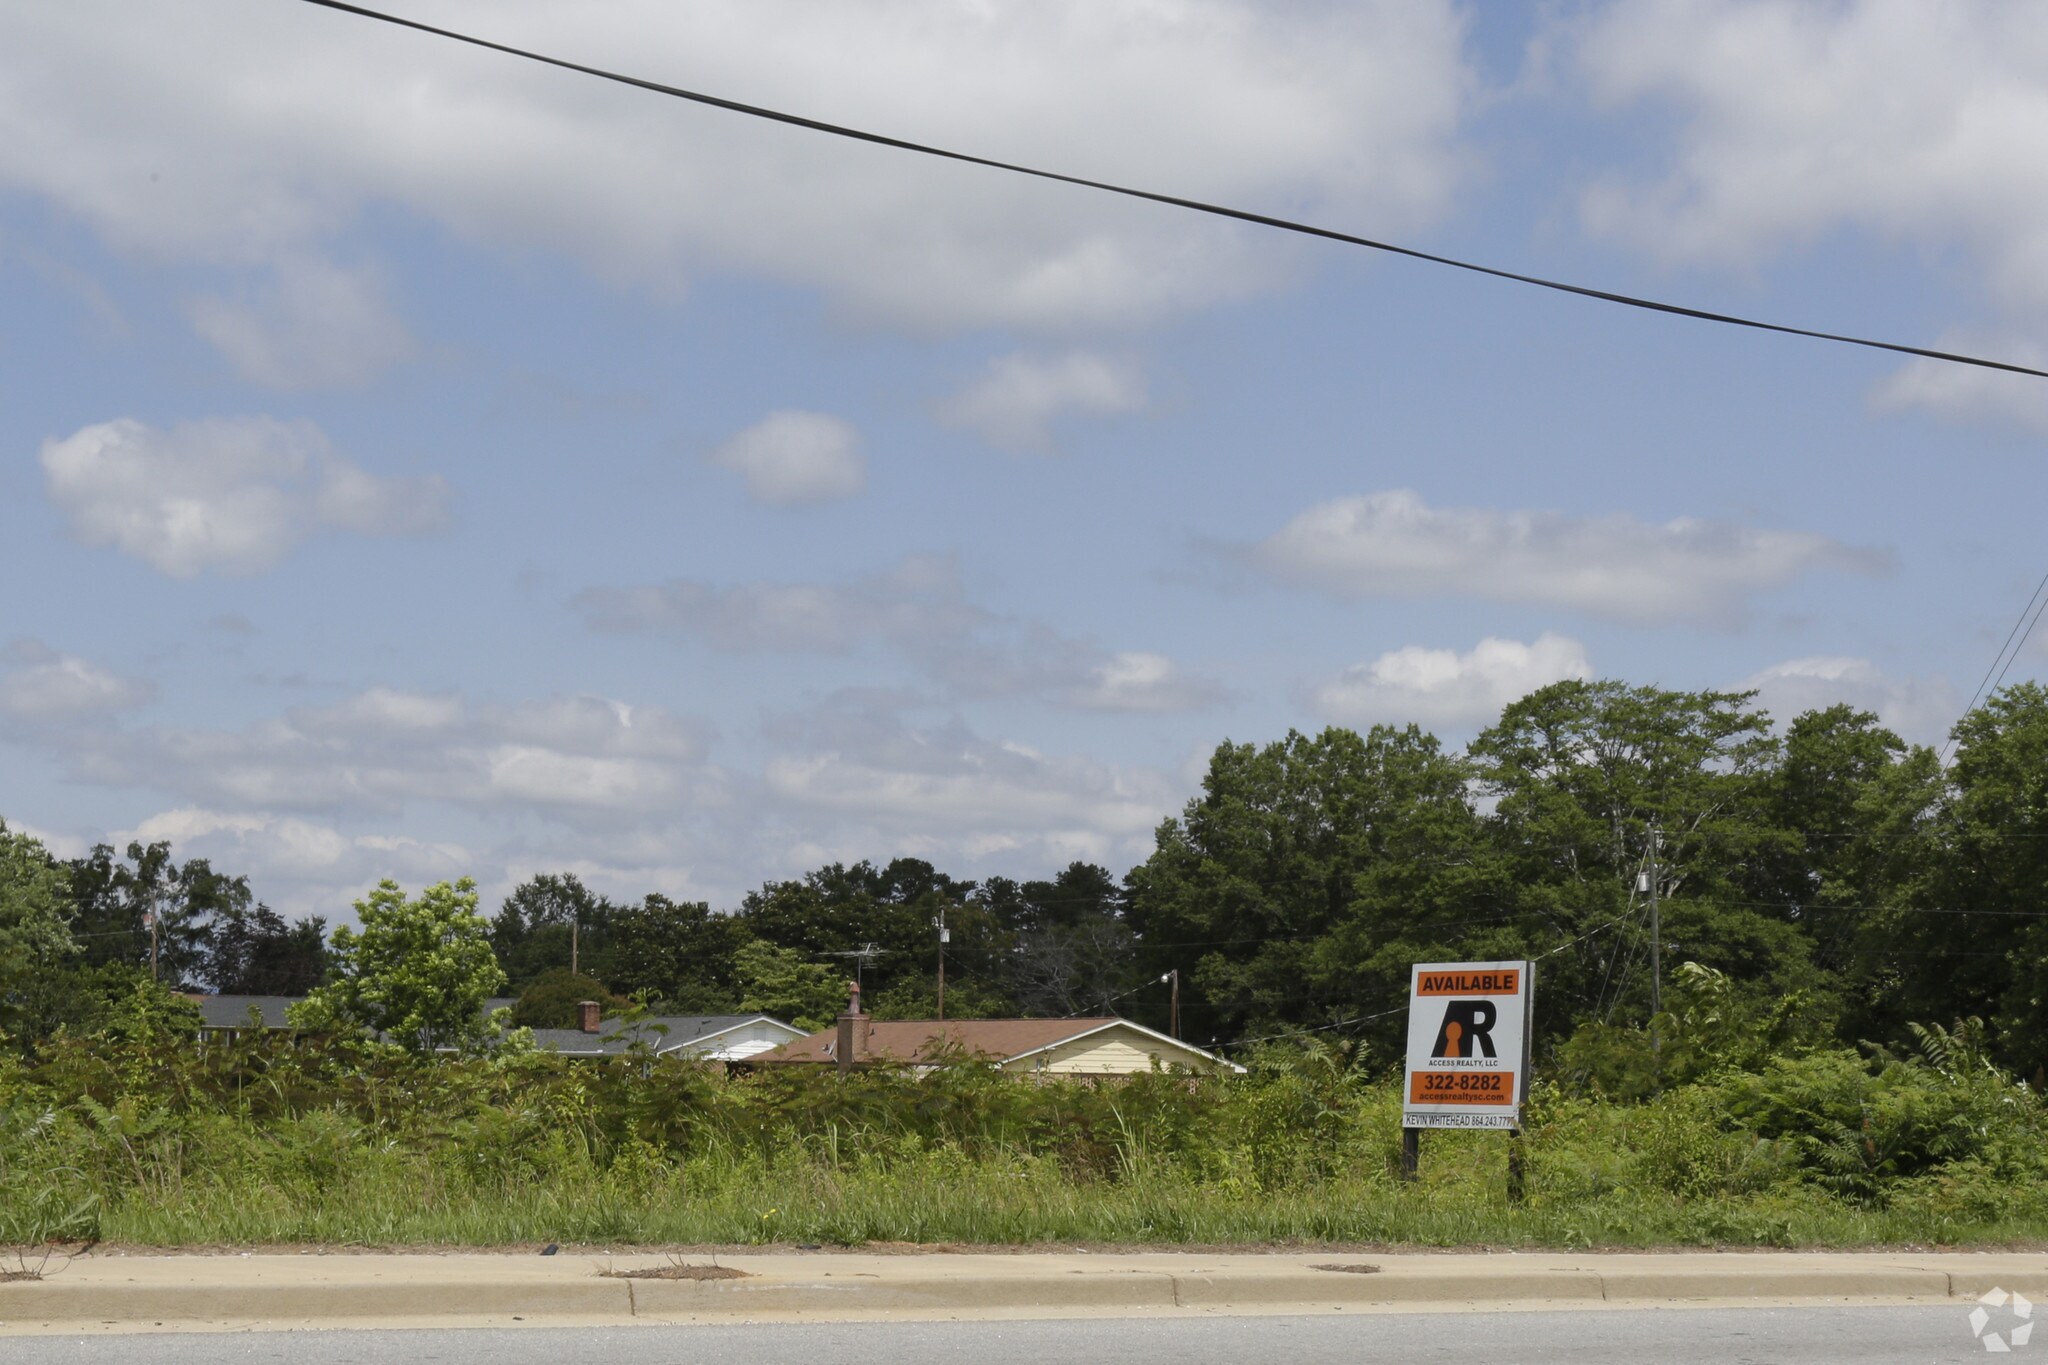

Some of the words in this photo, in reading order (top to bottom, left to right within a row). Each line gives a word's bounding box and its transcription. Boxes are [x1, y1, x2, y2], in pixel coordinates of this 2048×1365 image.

[1423, 975, 1513, 991] AVAILABLE
[1425, 1075, 1501, 1090] 322-8282
[1419, 1092, 1504, 1102] accessrealtysc.com
[1406, 1115, 1427, 1125] KEVIN
[1428, 1115, 1470, 1126] WHITEHEAD
